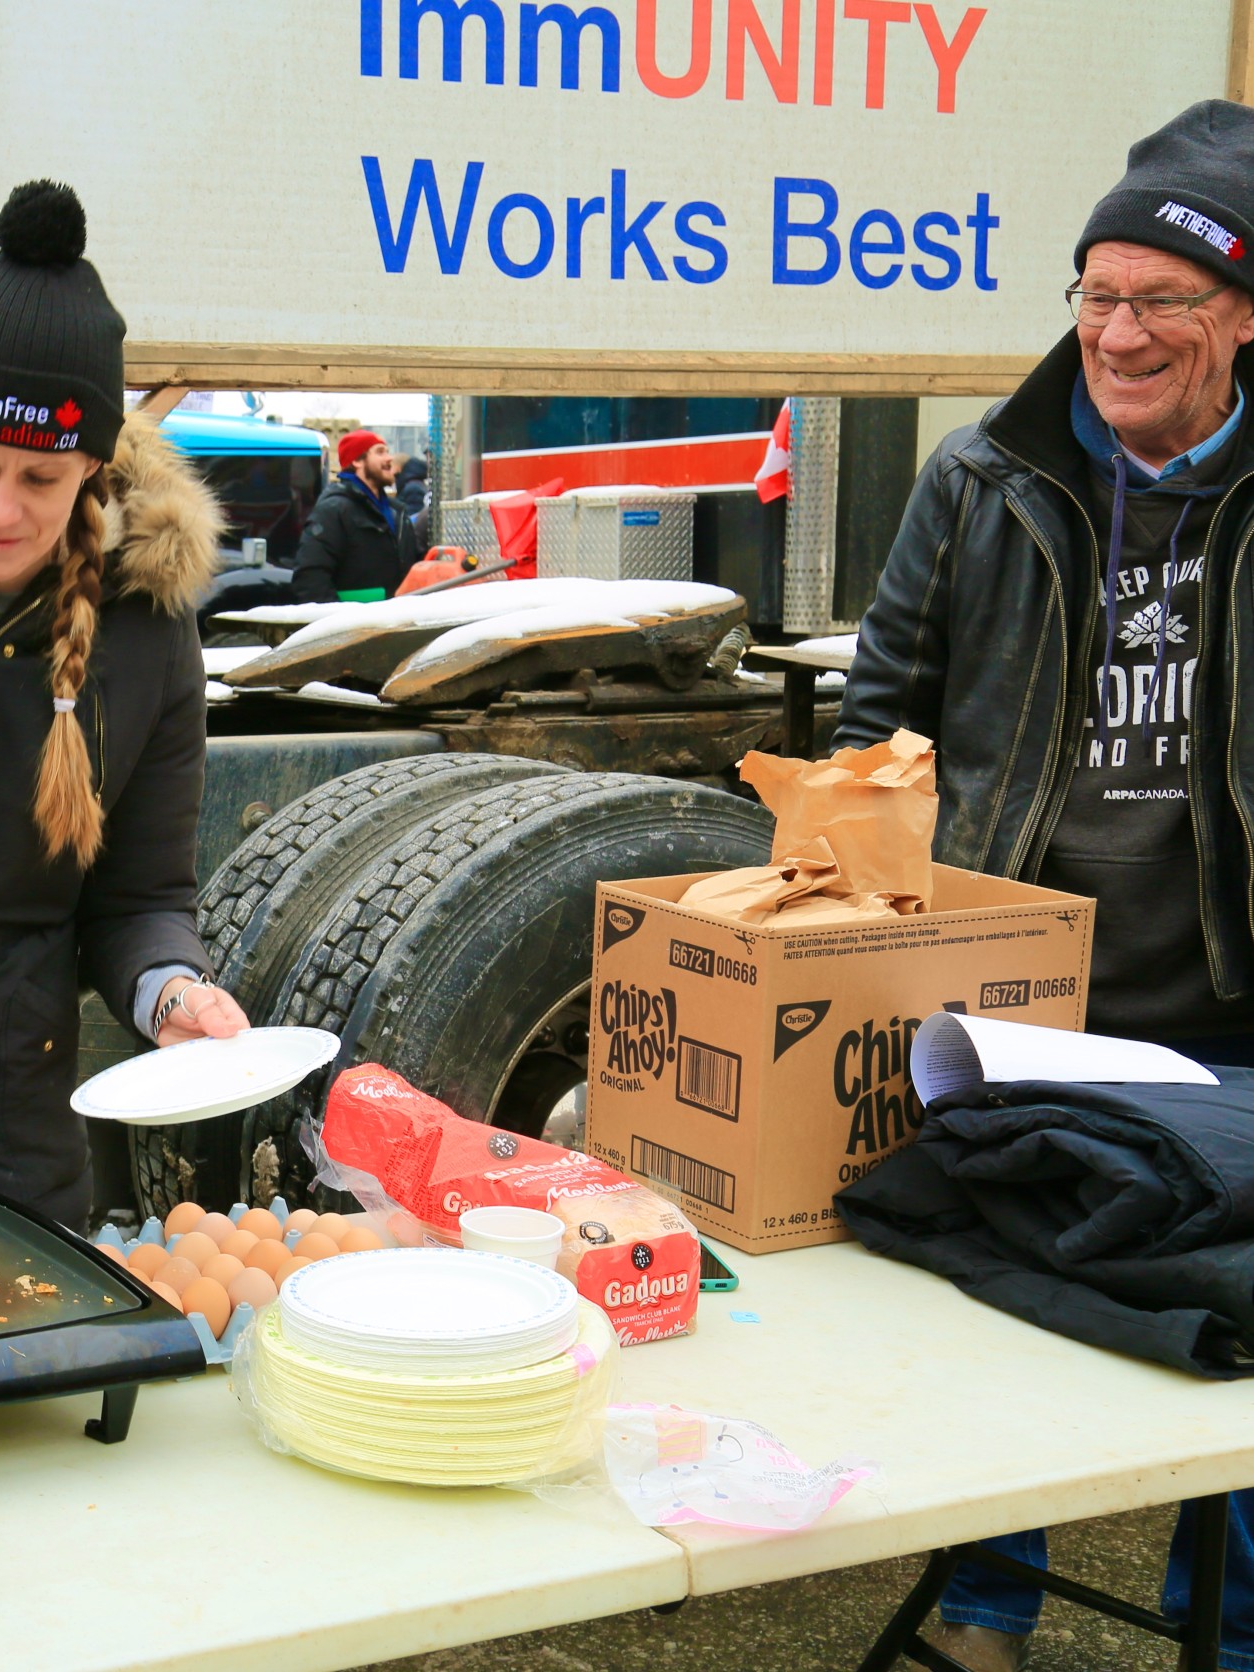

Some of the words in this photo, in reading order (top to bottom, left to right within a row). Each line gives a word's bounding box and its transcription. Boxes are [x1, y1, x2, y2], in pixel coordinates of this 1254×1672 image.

[360, 0, 988, 114] ImmUNITY
[359, 155, 729, 285] Works
[772, 176, 1001, 292] Best
[1154, 200, 1238, 256] #WETHEFRINGE
[783, 951, 803, 961] FAITES
[804, 947, 835, 958] ATTENTION
[837, 946, 853, 957] quand
[854, 945, 867, 954] vous
[868, 943, 887, 954] coupez
[888, 942, 894, 950] la
[910, 940, 922, 950] pour
[923, 939, 930, 947] ne
[931, 938, 941, 948] pas
[976, 933, 985, 942] les
[784, 940, 796, 949] USE
[797, 938, 822, 948] CAUTION
[824, 937, 838, 946] when
[840, 936, 860, 946] cutting.
[861, 933, 887, 943] Packages
[888, 930, 904, 939] inside
[905, 930, 917, 939] may
[918, 928, 941, 937] damage.
[672, 943, 710, 973] 66721
[717, 955, 758, 986] 00668
[982, 982, 1026, 1006] 66721
[1033, 976, 1076, 1000] 00668
[600, 979, 664, 1035] Chips
[785, 1013, 813, 1026] Christie
[607, 987, 677, 1081] Ahoy!
[834, 1015, 919, 1108] Chip
[600, 1070, 646, 1093] ORIGINAL
[845, 1082, 926, 1156] Aho
[497, 1140, 517, 1157] 1911
[594, 1141, 602, 1153] 12
[603, 1147, 607, 1155] x
[608, 1148, 620, 1161] 460
[621, 1155, 626, 1166] g
[763, 1216, 776, 1229] 12
[779, 1218, 786, 1227] x
[788, 1212, 808, 1225] 460
[811, 1212, 818, 1224] g
[635, 1256, 650, 1265] 1911
[604, 1273, 688, 1308] Gadoua
[612, 1313, 646, 1325] SANDWICH
[646, 1310, 663, 1319] CLUB
[663, 1305, 681, 1315] BLANC
